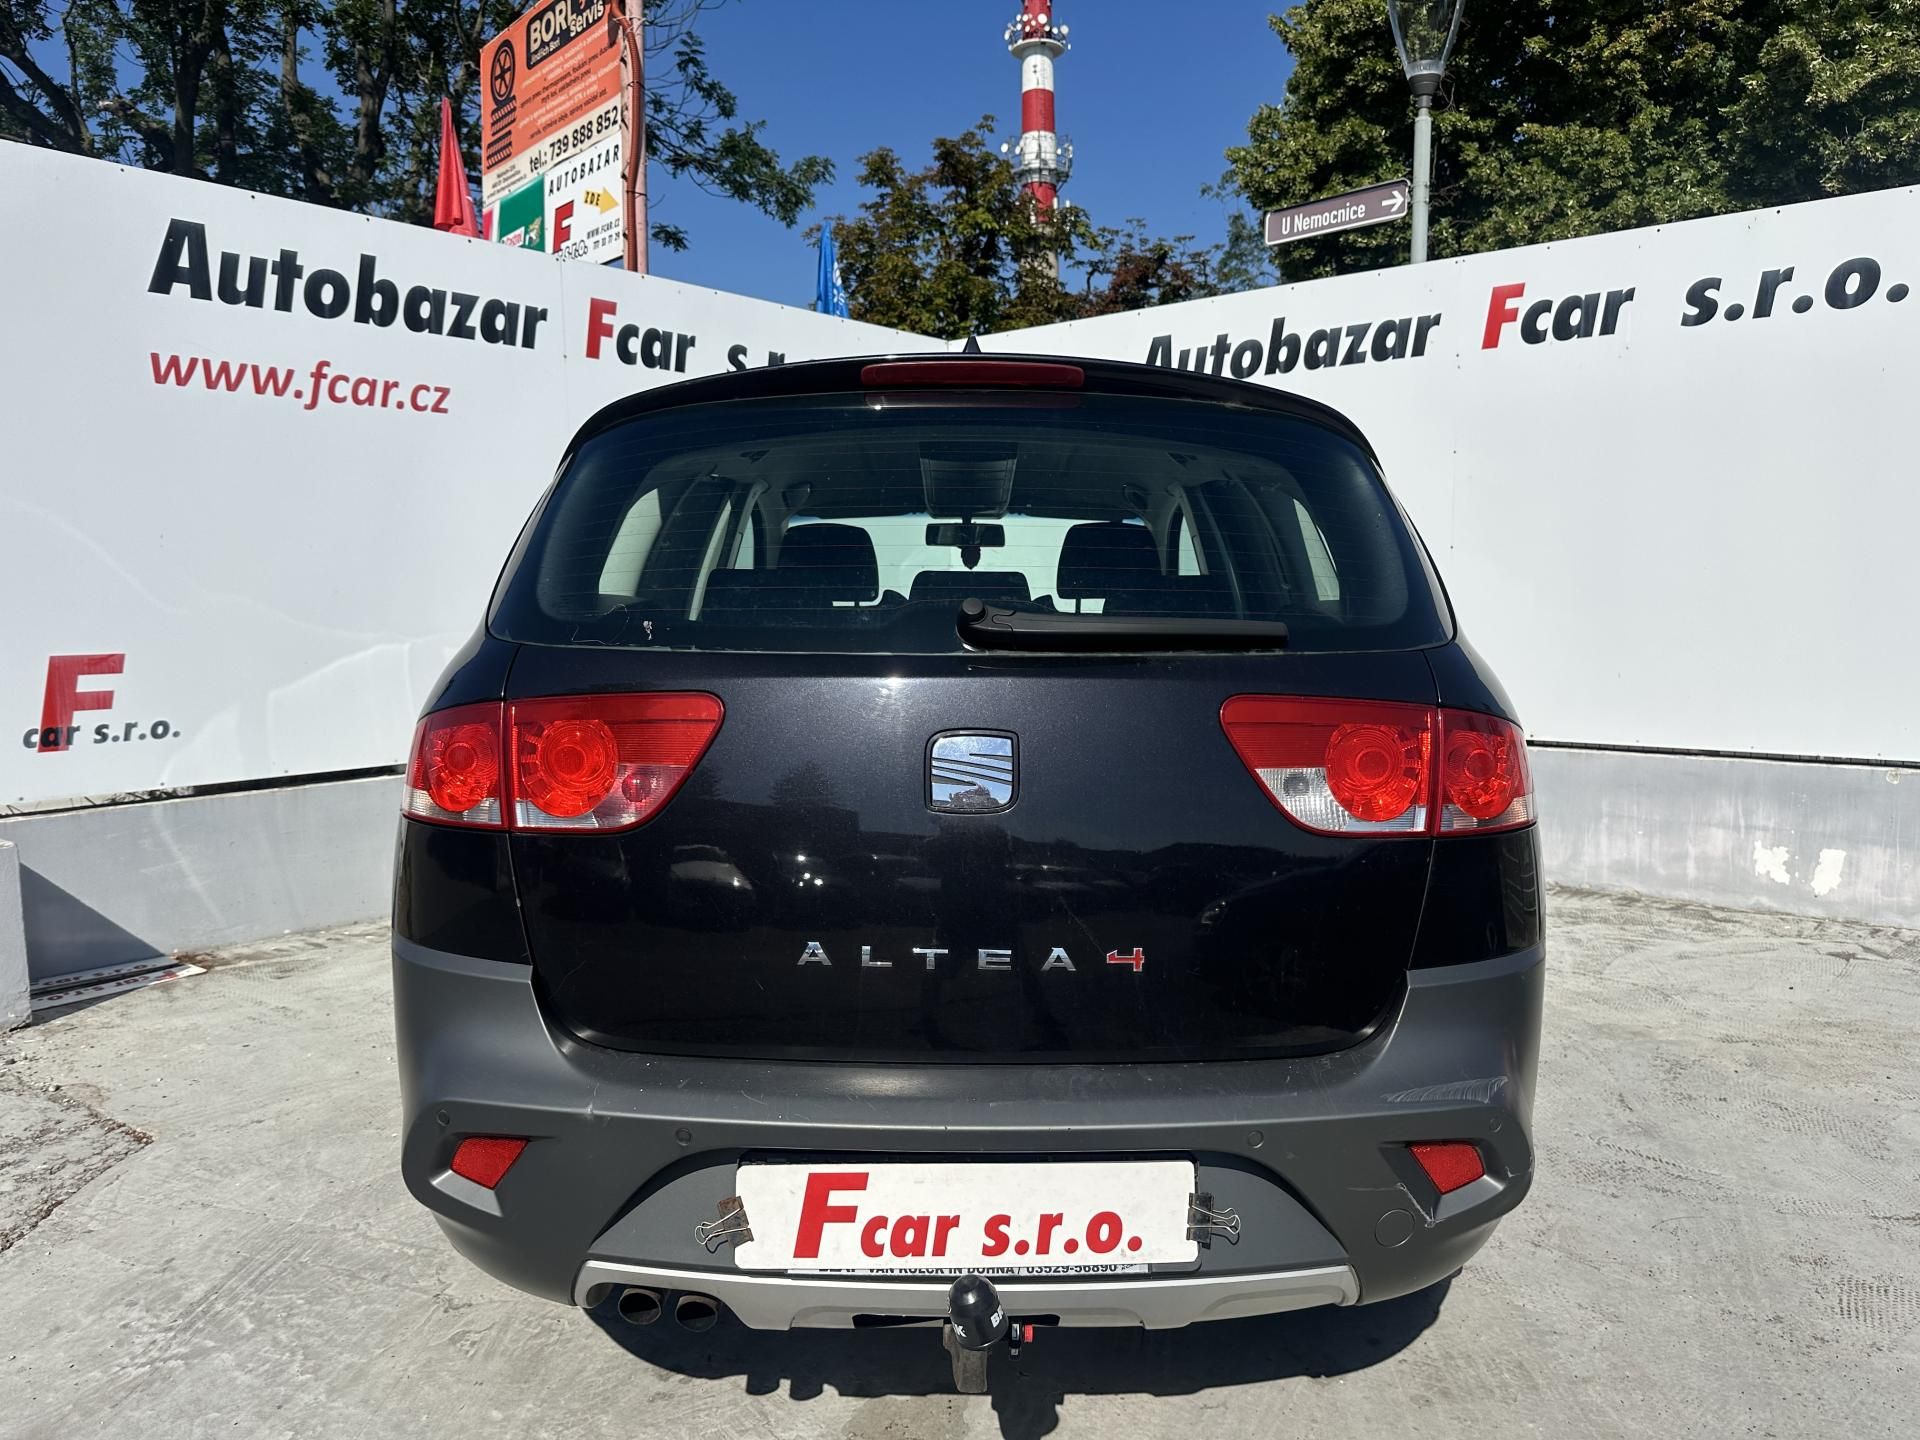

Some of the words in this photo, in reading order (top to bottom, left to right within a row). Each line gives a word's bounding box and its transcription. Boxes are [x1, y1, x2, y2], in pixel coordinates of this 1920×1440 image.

[549, 139, 570, 161] 739
[572, 121, 594, 148] 888
[596, 105, 619, 135] 852
[548, 143, 620, 197] AUTOBAZAR
[584, 191, 600, 206] ZDE
[1281, 216, 1291, 235] U
[1294, 202, 1366, 233] Nemocnice
[147, 218, 548, 350] Autobazar
[585, 297, 696, 373] Fcar
[1145, 312, 1442, 379] Autobazar
[1481, 282, 1636, 350] Fcar
[1679, 257, 1910, 328] s.r.o.
[149, 352, 451, 414] www.fcar.cz
[93, 720, 181, 745] s.r.o.
[797, 941, 1077, 972] ALTEA
[1106, 947, 1145, 972] 4
[981, 1210, 1143, 1258] s.r.o.
